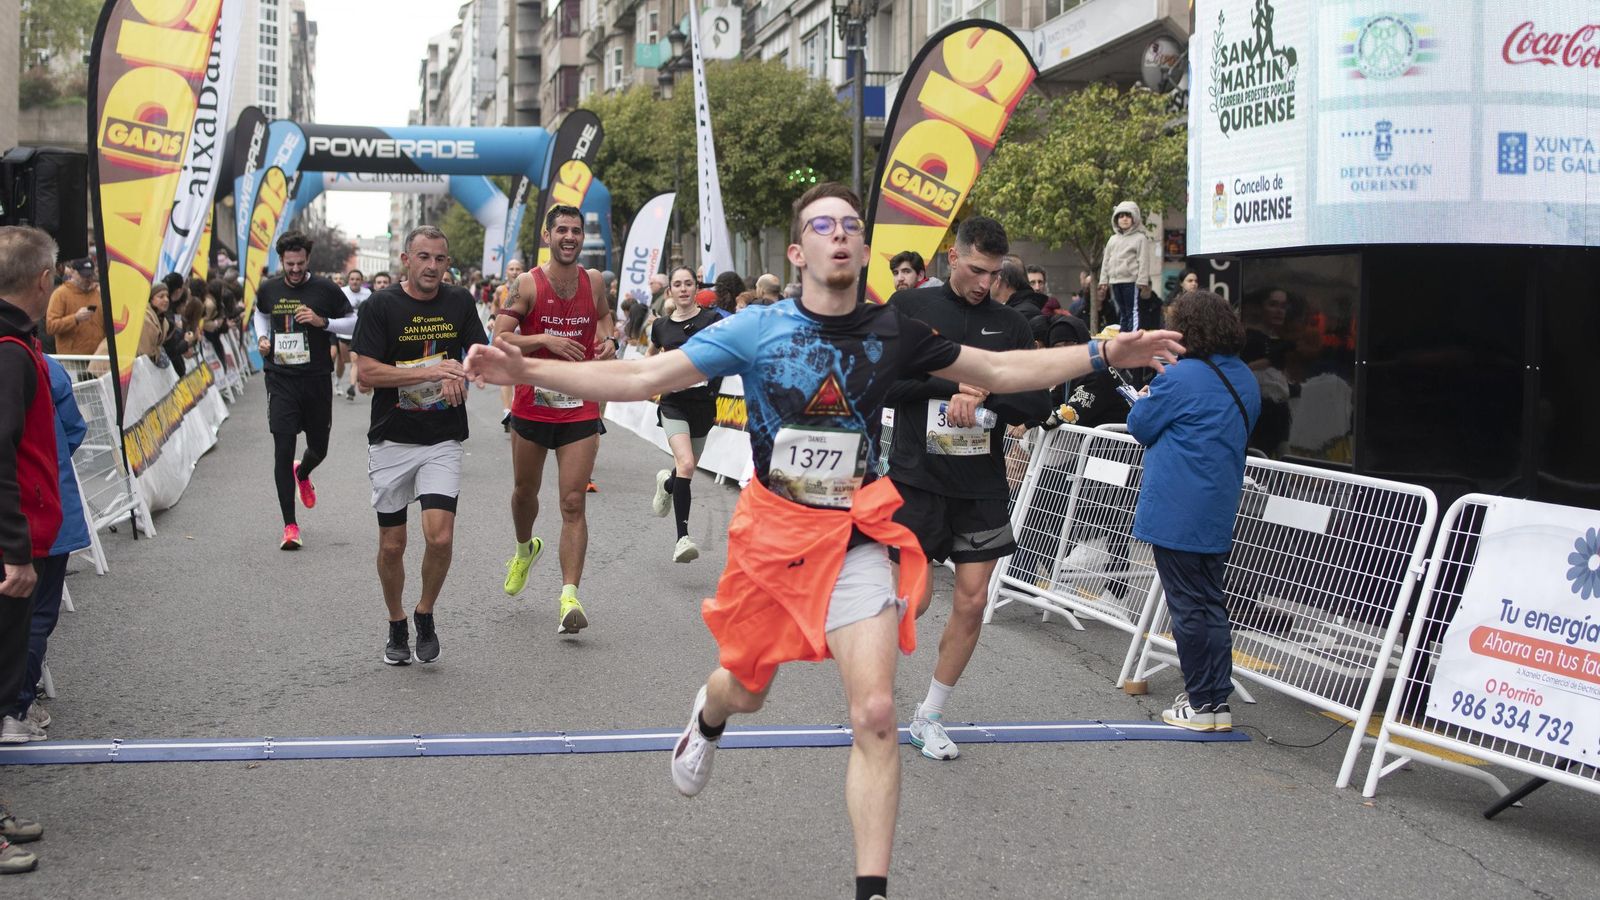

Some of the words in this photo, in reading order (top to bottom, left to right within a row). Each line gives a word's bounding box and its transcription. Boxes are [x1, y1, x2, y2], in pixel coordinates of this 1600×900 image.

[1221, 38, 1253, 67] SAN
[1221, 57, 1284, 94] MARTIN
[1220, 92, 1244, 108] CARREIRA
[1245, 86, 1270, 103] PEDESTRE
[1271, 80, 1295, 97] POPULAR
[106, 122, 183, 157] GADIS
[309, 136, 475, 159] POWERADE
[1535, 136, 1594, 154] XUNTA
[1340, 162, 1433, 179] DEPUTACIÓN
[1533, 156, 1556, 172] DE
[237, 121, 266, 241] POWERADE
[889, 166, 959, 213] GADIS
[1234, 175, 1271, 196] Concello
[1272, 173, 1284, 190] de
[1350, 179, 1417, 192] OURENSE
[1233, 195, 1293, 224] OURENSE
[626, 246, 649, 285] chc
[404, 326, 419, 334] SAN
[420, 322, 453, 333] MARTIÑO
[541, 315, 564, 325] ALEX
[565, 316, 590, 325] TEAM
[398, 334, 427, 342] CONCELLO
[807, 435, 827, 444] DANIEL
[790, 445, 843, 470] 1377
[1500, 598, 1521, 624] Tu
[1482, 631, 1533, 659] Ahorra
[1534, 649, 1554, 665] en
[1556, 649, 1580, 671] tus
[1485, 678, 1497, 694] O
[1499, 682, 1544, 707] Porriño
[1451, 690, 1487, 720] 986
[1491, 702, 1531, 733] 334
[1535, 713, 1574, 746] 732
